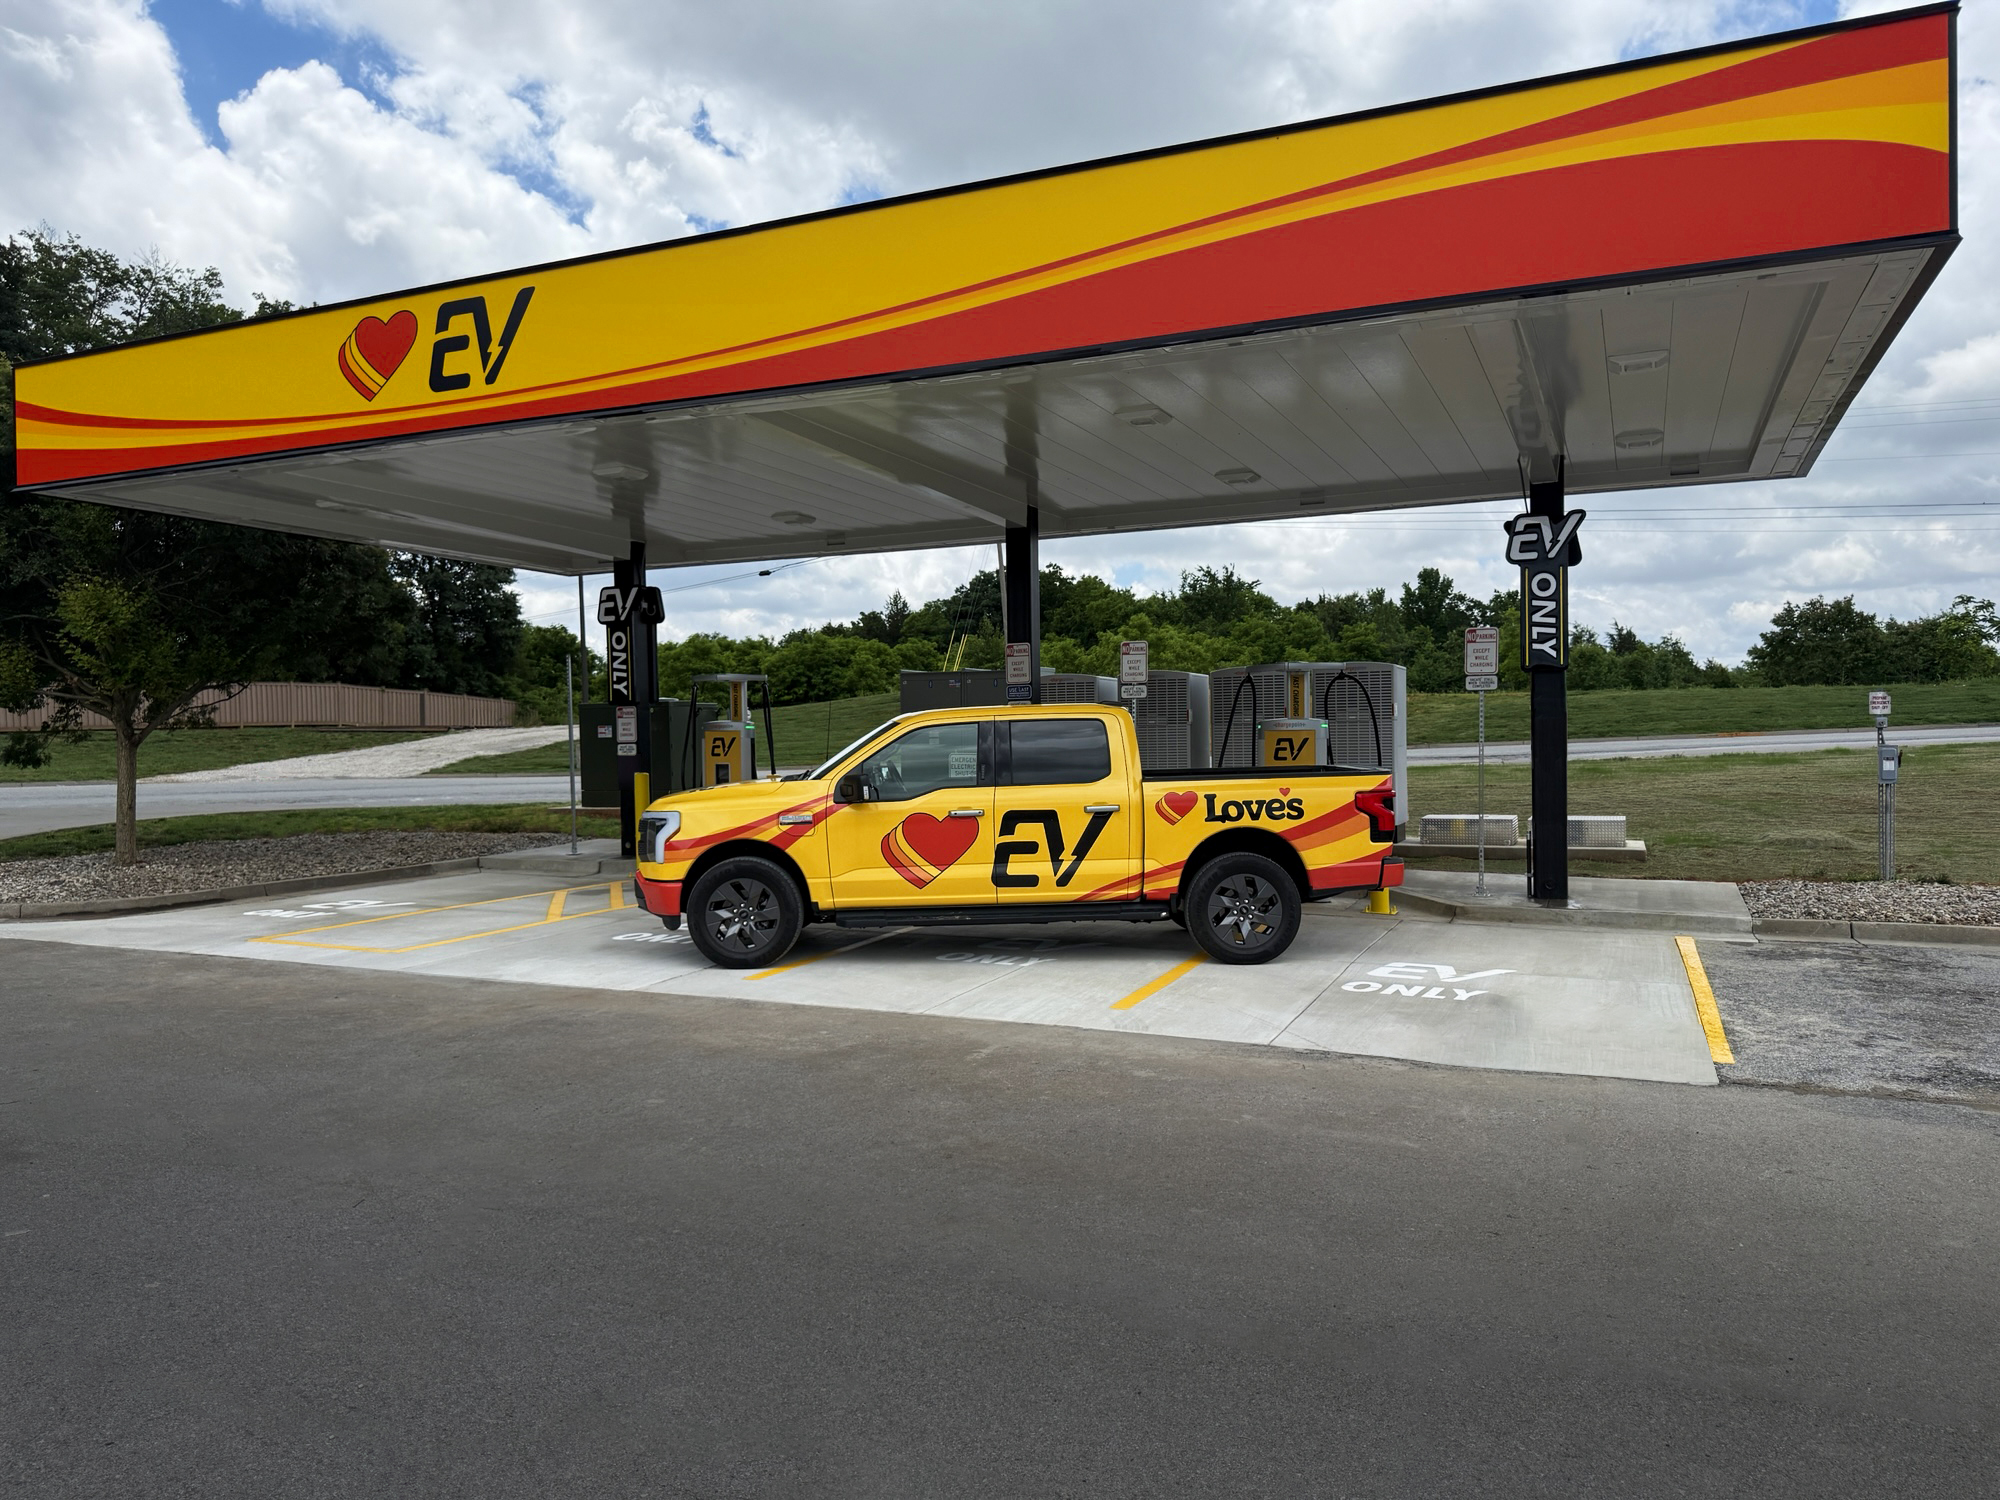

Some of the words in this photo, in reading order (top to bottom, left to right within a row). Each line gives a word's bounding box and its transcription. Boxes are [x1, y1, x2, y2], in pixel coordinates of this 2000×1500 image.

[429, 286, 536, 392] EV
[1509, 512, 1583, 561] EV
[599, 587, 639, 622] EV
[1531, 572, 1557, 659] ONLY
[1467, 633, 1476, 641] NO
[612, 631, 628, 695] ONLY
[711, 737, 737, 757] EV
[1273, 737, 1310, 761] EV
[991, 809, 1114, 888] EV
[936, 952, 1057, 967] ONLY
[1366, 962, 1518, 983] EV
[1341, 981, 1490, 1001] ONLY
